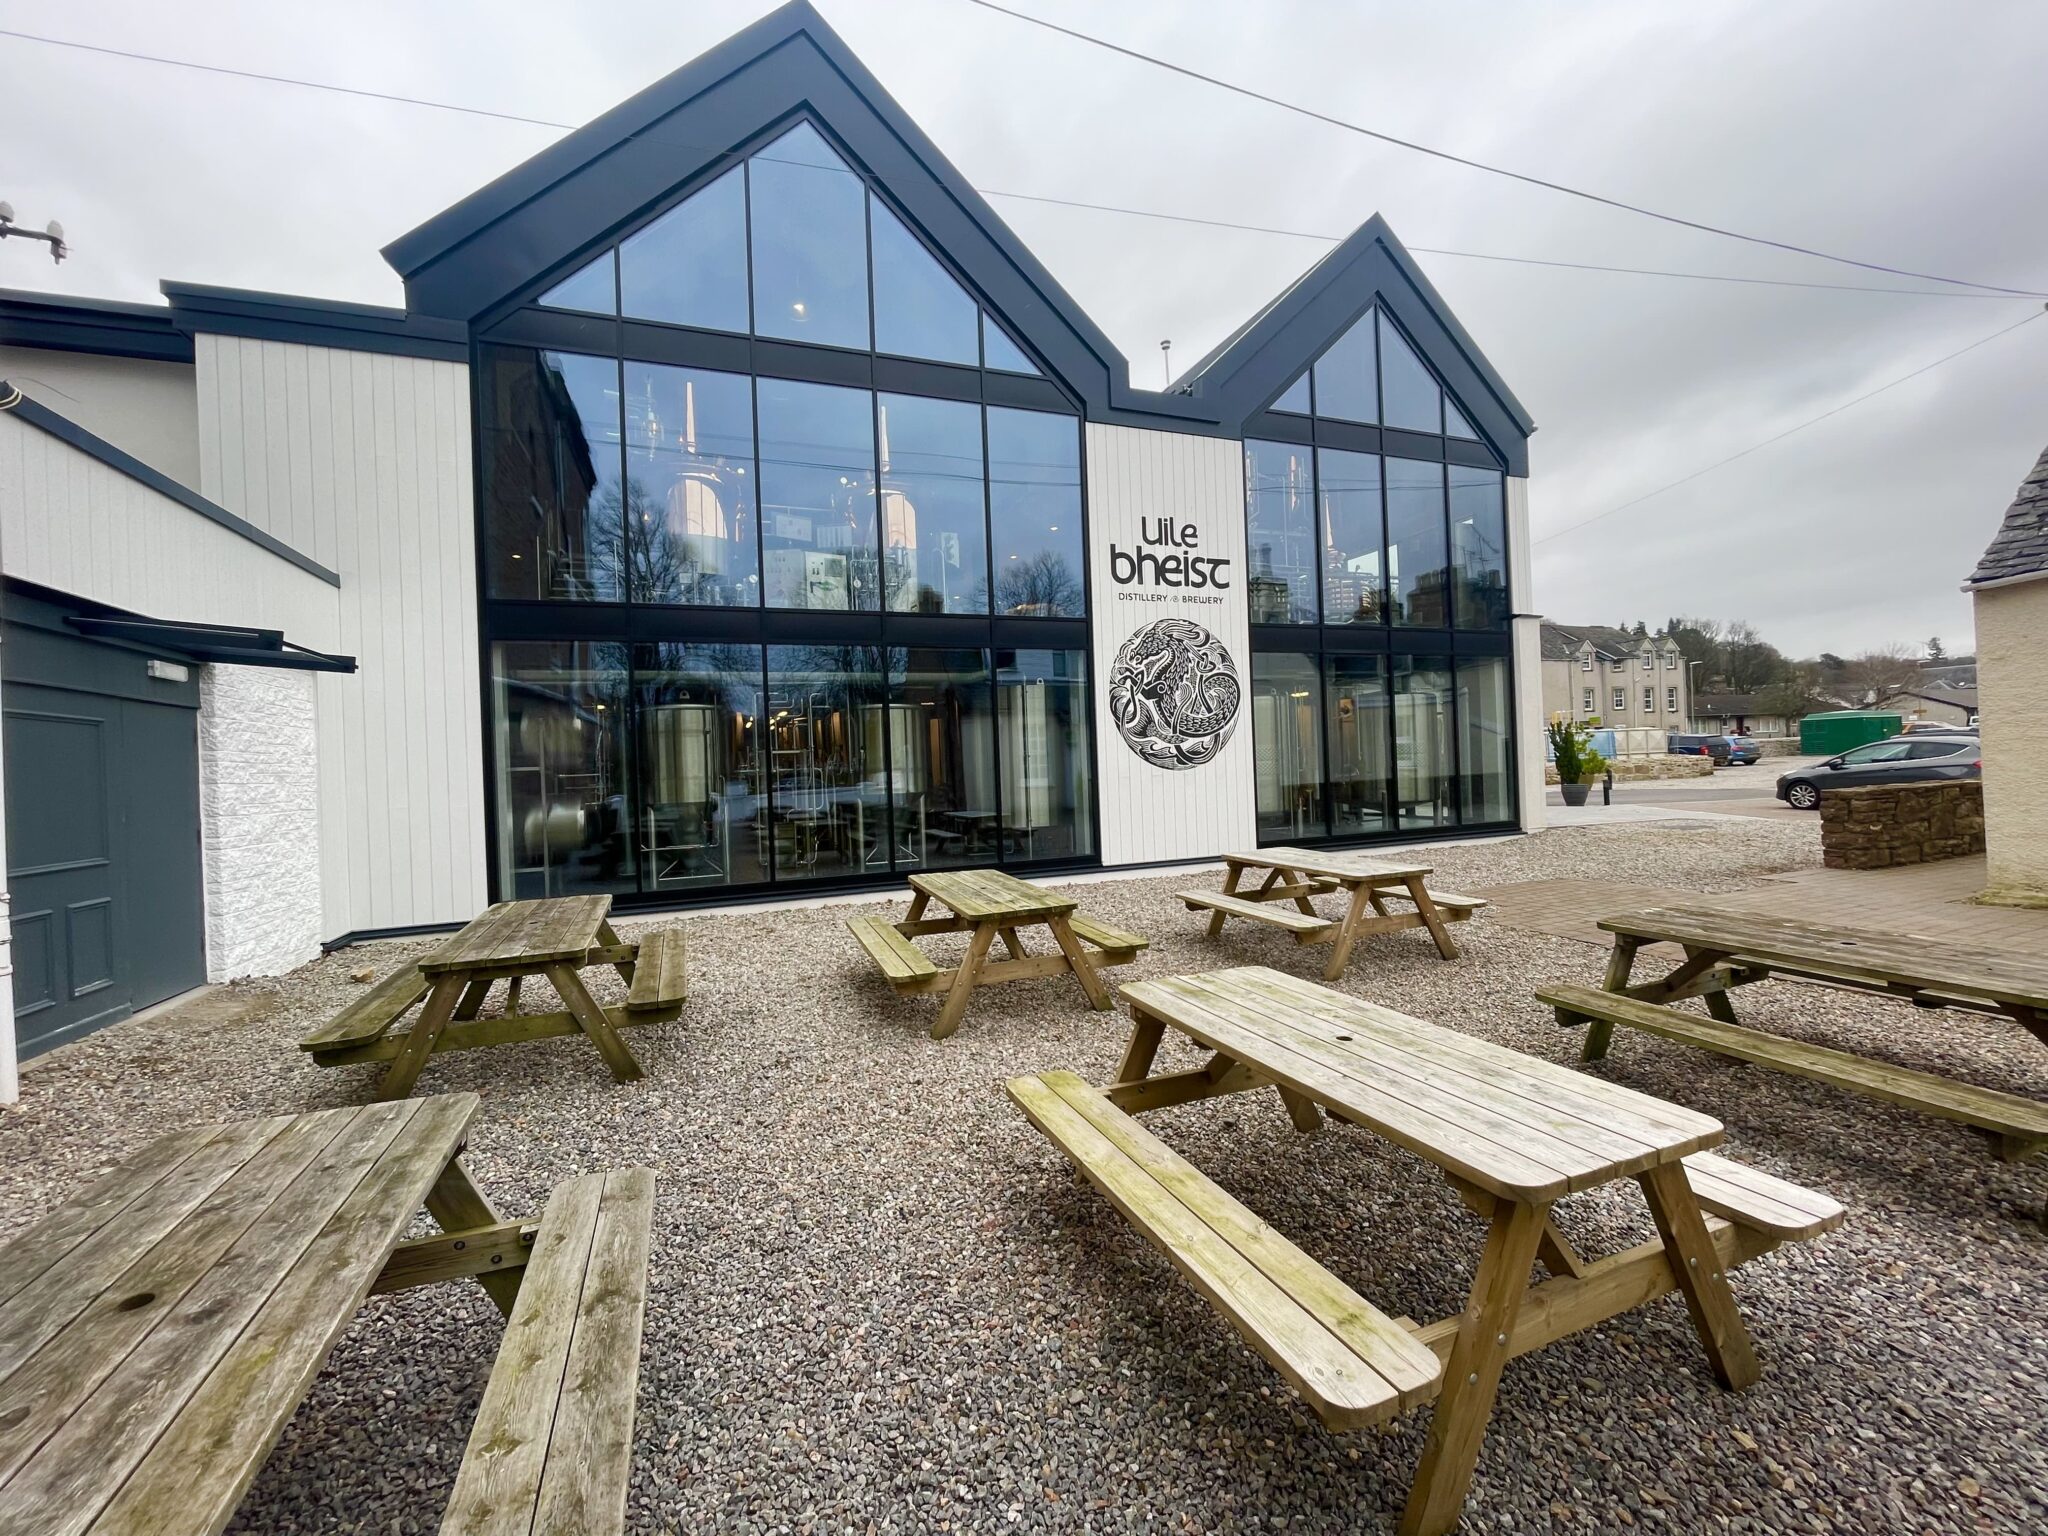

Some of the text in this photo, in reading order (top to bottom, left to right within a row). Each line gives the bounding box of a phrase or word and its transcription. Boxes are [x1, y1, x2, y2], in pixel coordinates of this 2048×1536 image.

[1110, 543, 1231, 590] bheist
[1118, 592, 1224, 605] DISTILLERY BREWERY
